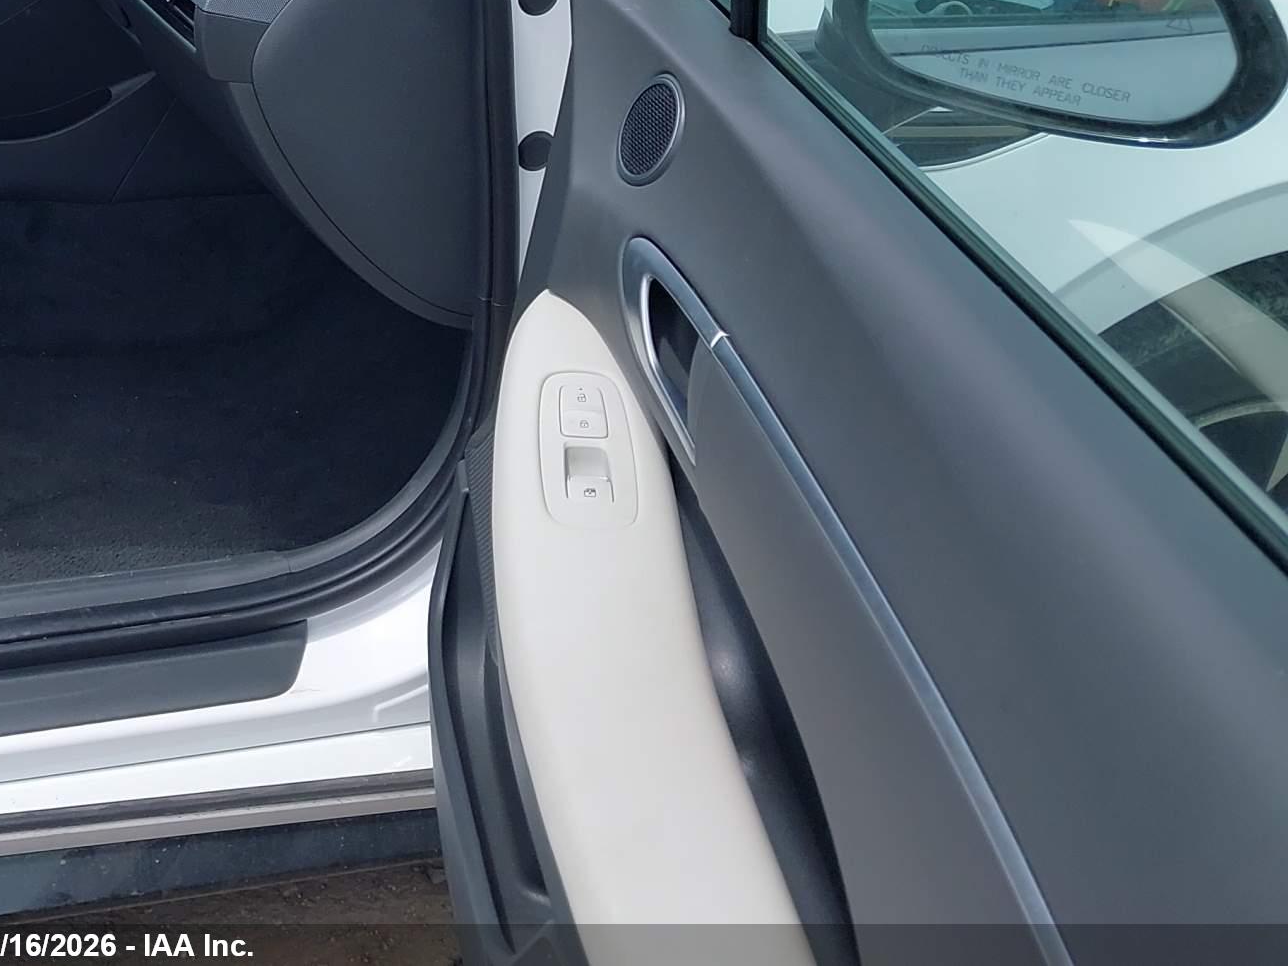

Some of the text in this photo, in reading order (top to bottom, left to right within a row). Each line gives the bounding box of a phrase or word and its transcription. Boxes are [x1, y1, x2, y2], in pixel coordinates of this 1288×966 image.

[960, 67, 1082, 107] THAN THEY APPEAR
[977, 56, 990, 68] IN
[997, 61, 1042, 82] MIRROR
[1048, 74, 1073, 90] ARE
[1082, 82, 1132, 104] CLOSER
